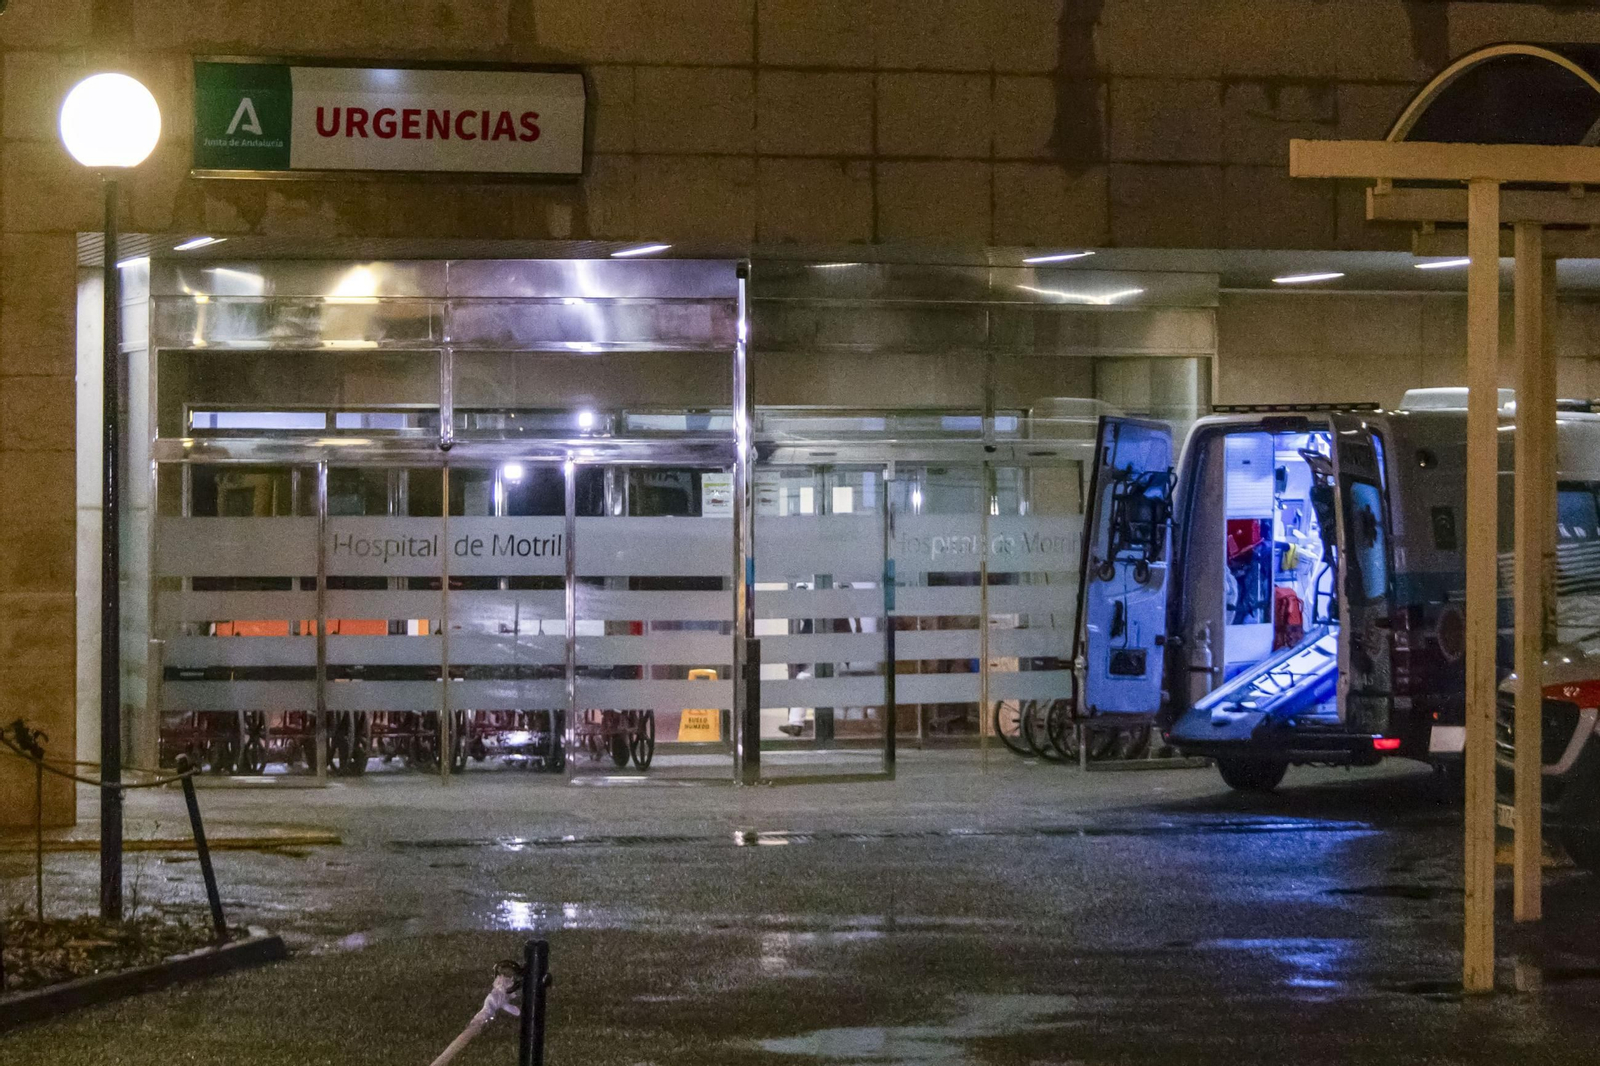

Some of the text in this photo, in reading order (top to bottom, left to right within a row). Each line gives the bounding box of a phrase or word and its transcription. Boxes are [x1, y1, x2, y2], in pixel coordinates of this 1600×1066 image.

[315, 106, 541, 142] URGENCIAS
[333, 534, 562, 563] Hospital de Motril
